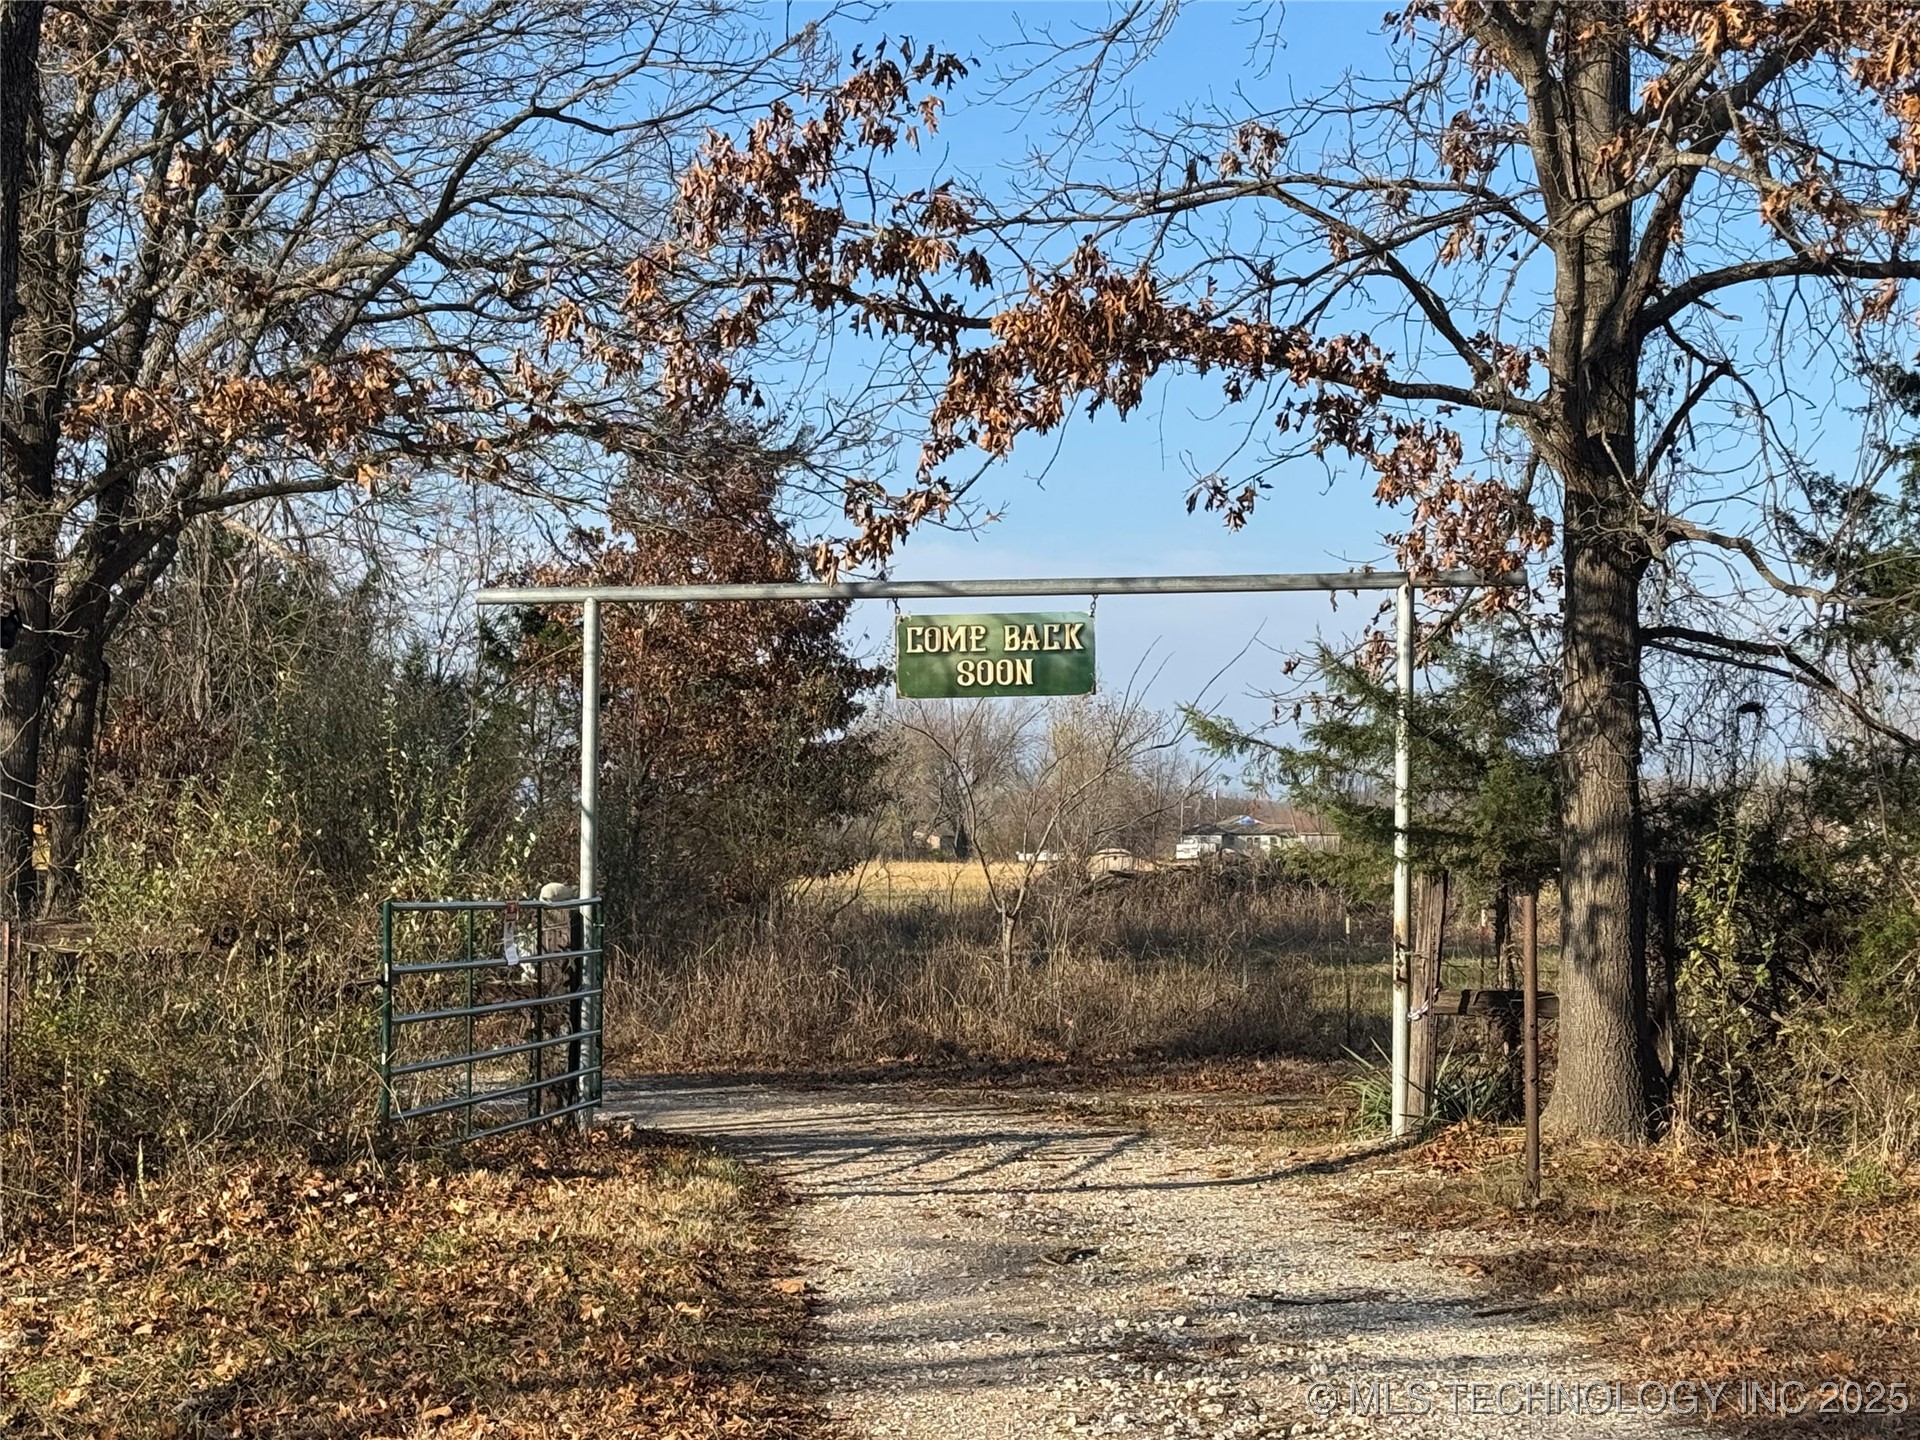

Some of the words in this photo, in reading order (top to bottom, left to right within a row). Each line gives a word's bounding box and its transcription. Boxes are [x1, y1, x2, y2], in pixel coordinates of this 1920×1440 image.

[906, 625, 987, 654] COME
[1003, 622, 1085, 652] BACK
[956, 658, 1034, 687] SOON
